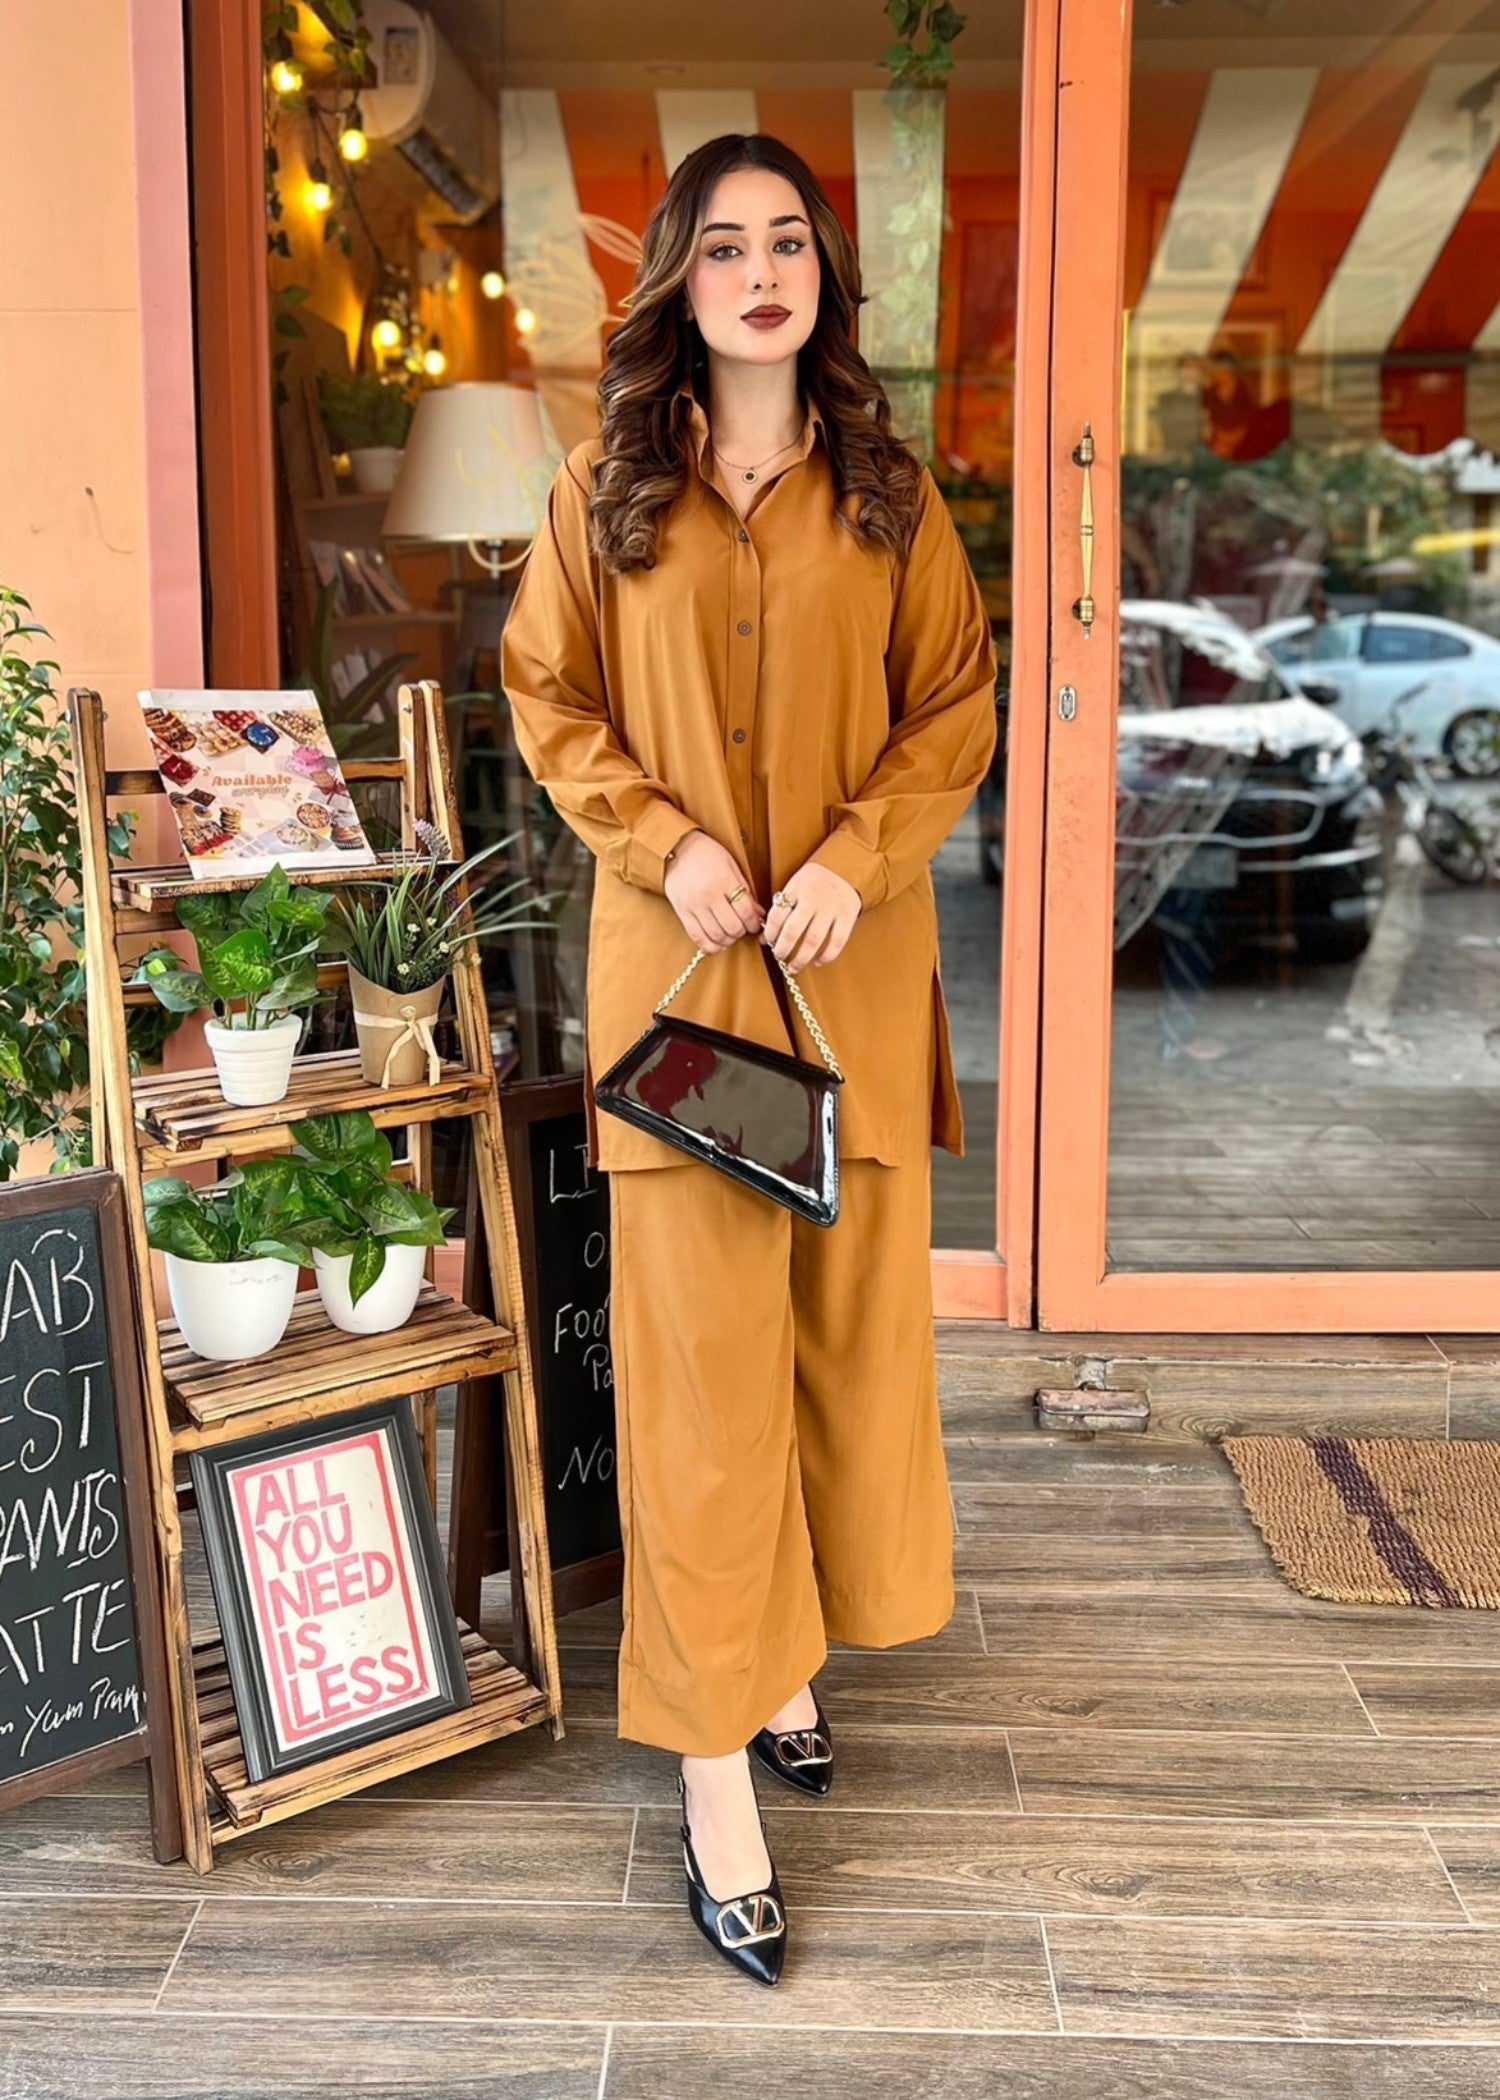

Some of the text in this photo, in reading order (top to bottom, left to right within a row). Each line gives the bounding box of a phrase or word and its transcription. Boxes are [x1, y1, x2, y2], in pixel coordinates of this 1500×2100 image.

[212, 774, 292, 786] Available
[255, 1459, 346, 1527] ALL
[256, 1503, 354, 1573] YOU
[267, 1551, 394, 1628] NEED
[278, 1622, 327, 1676] IS
[288, 1645, 414, 1728] LESS
